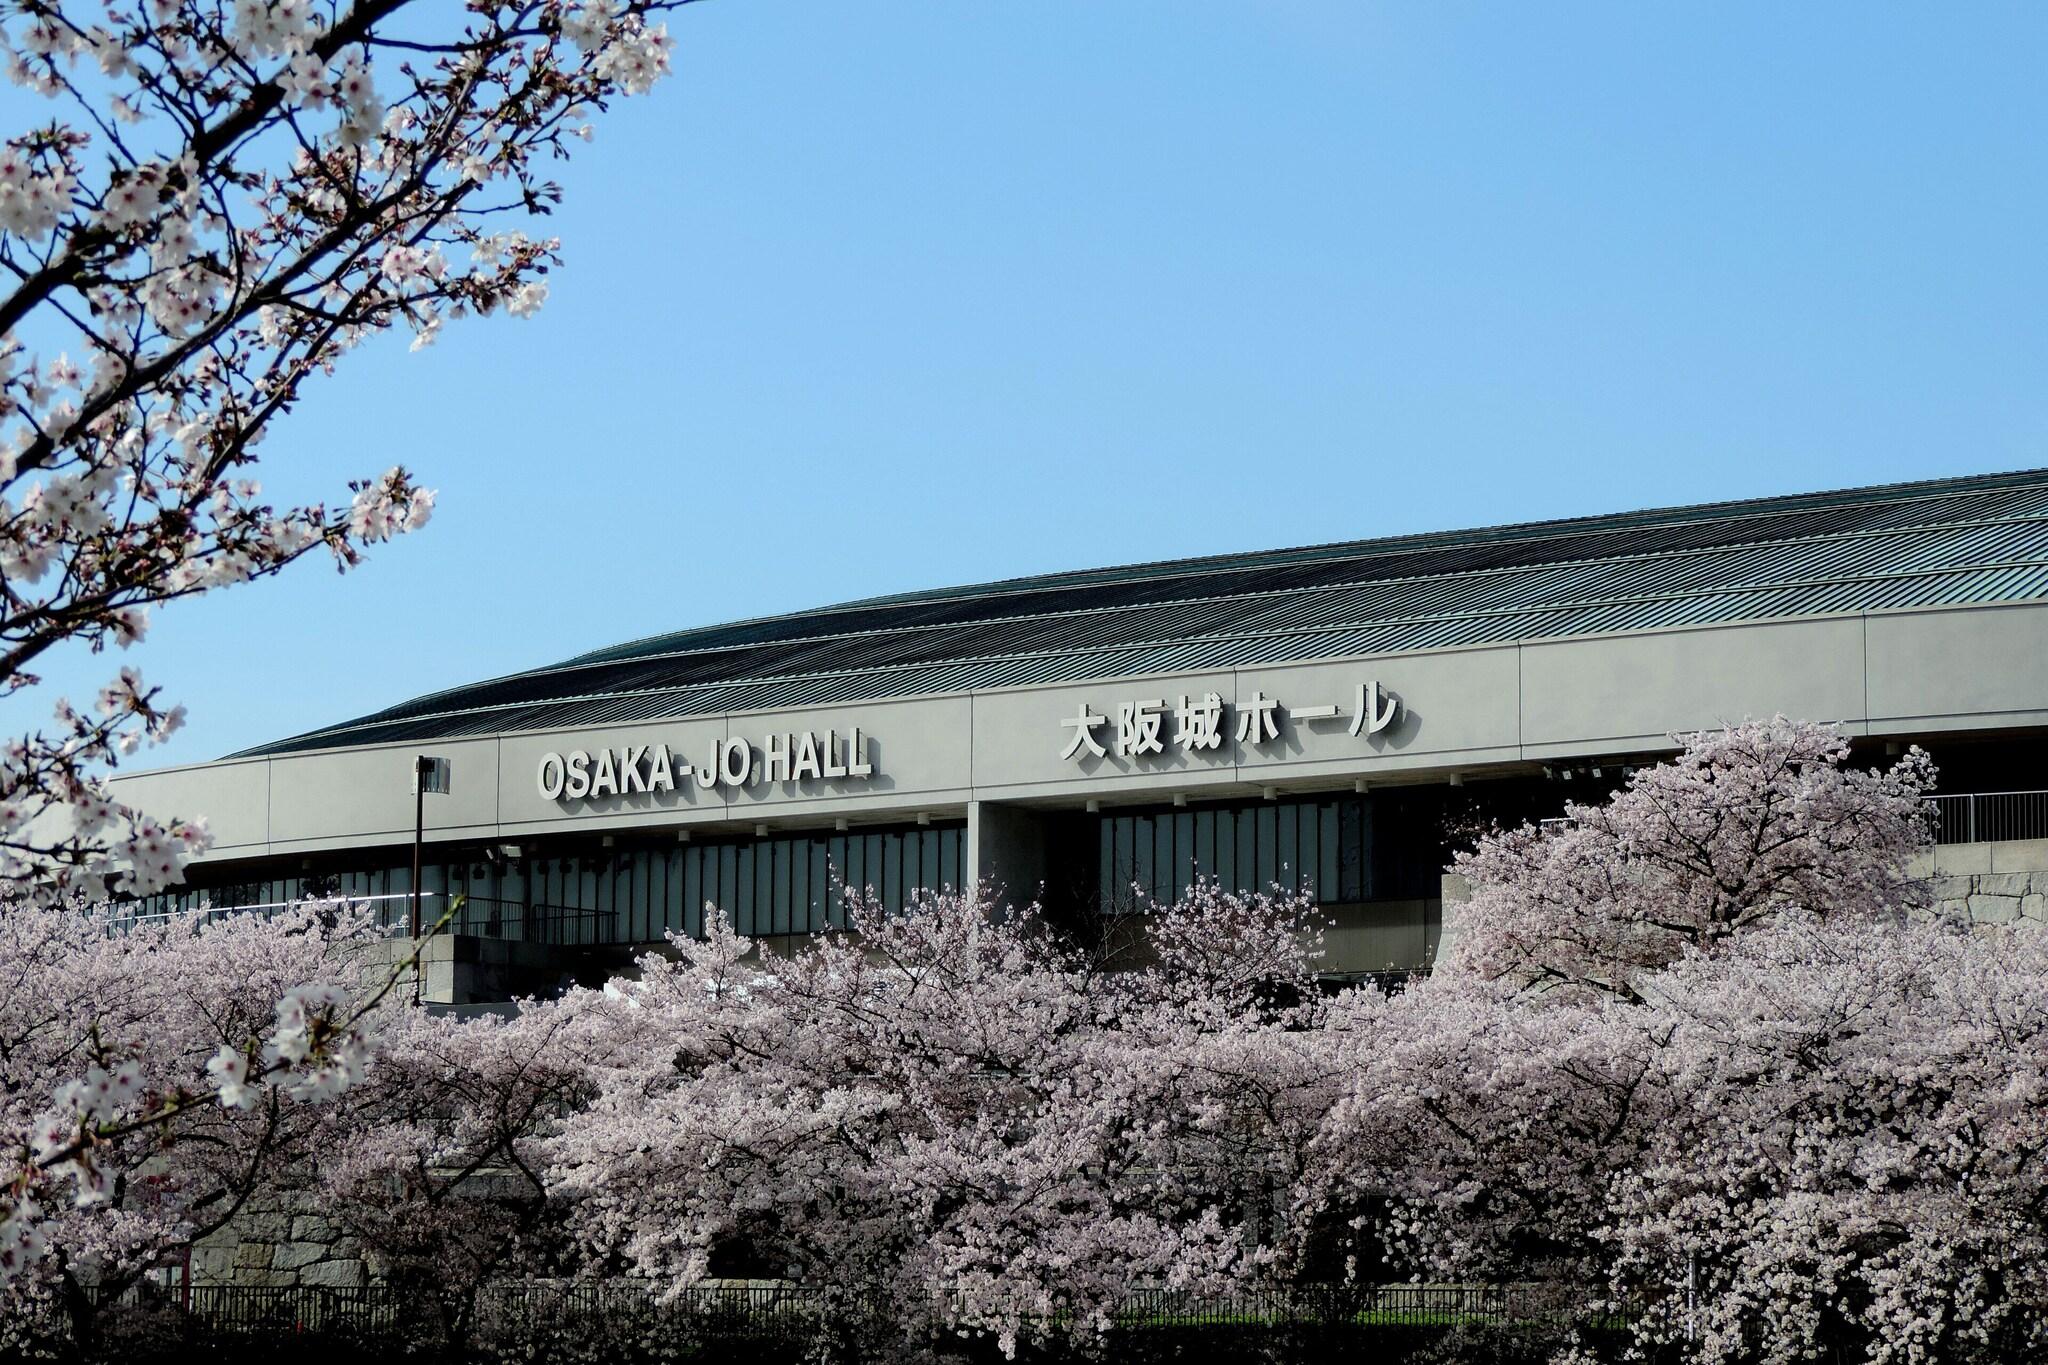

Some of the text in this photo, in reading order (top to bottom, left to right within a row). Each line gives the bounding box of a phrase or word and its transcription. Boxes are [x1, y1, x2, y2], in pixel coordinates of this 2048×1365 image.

[1060, 681, 1398, 760] 大阪城ホール
[765, 727, 872, 782] HALL
